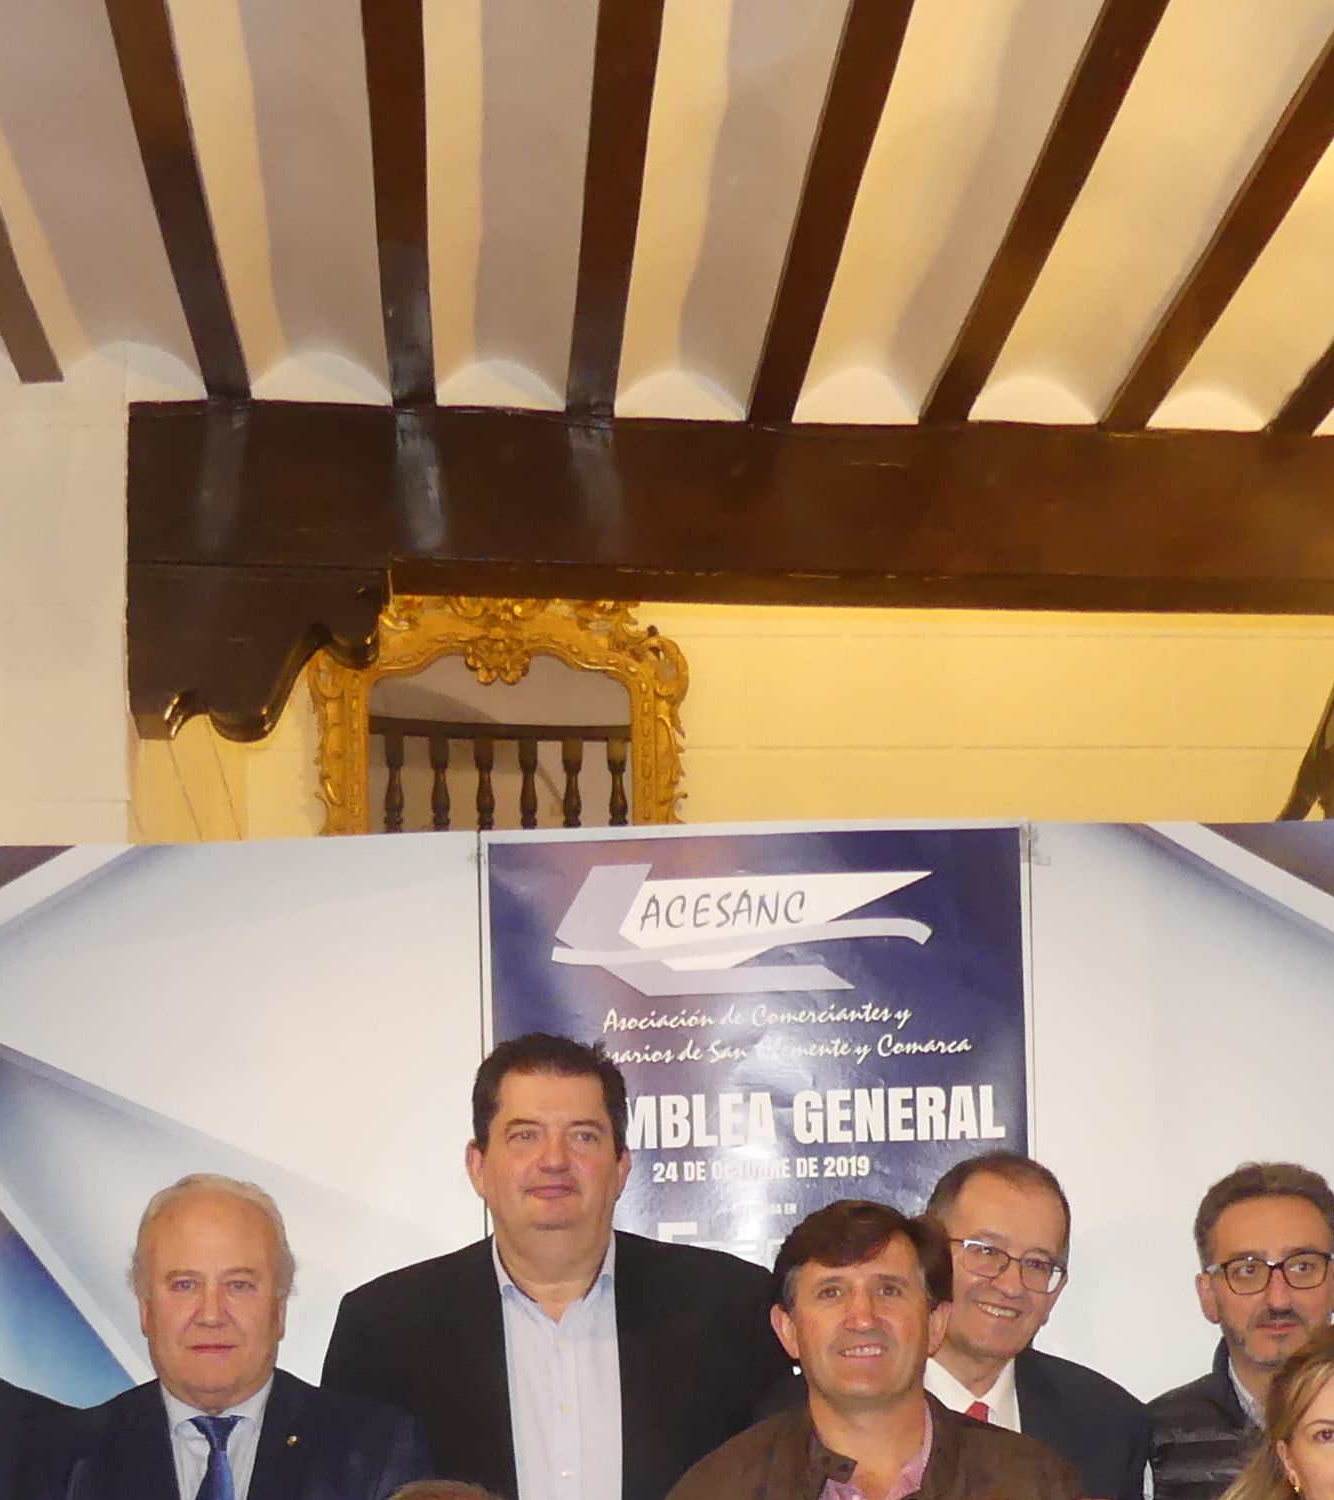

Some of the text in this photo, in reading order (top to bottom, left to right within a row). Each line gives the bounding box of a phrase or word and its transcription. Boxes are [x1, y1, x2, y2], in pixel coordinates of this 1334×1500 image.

[639, 889, 806, 931] ACESANC
[603, 1003, 912, 1034] Asociación de Comerciantes y
[605, 1045, 674, 1065] sarios
[676, 1039, 704, 1064] de
[707, 1039, 748, 1064] San
[854, 1043, 872, 1064] y
[876, 1034, 972, 1059] Comarca
[627, 1084, 1006, 1150] MBLEA GENERAL
[653, 1161, 679, 1184] 24
[683, 1160, 707, 1182] DE
[796, 1156, 819, 1178] DE
[823, 1155, 871, 1177] 2019
